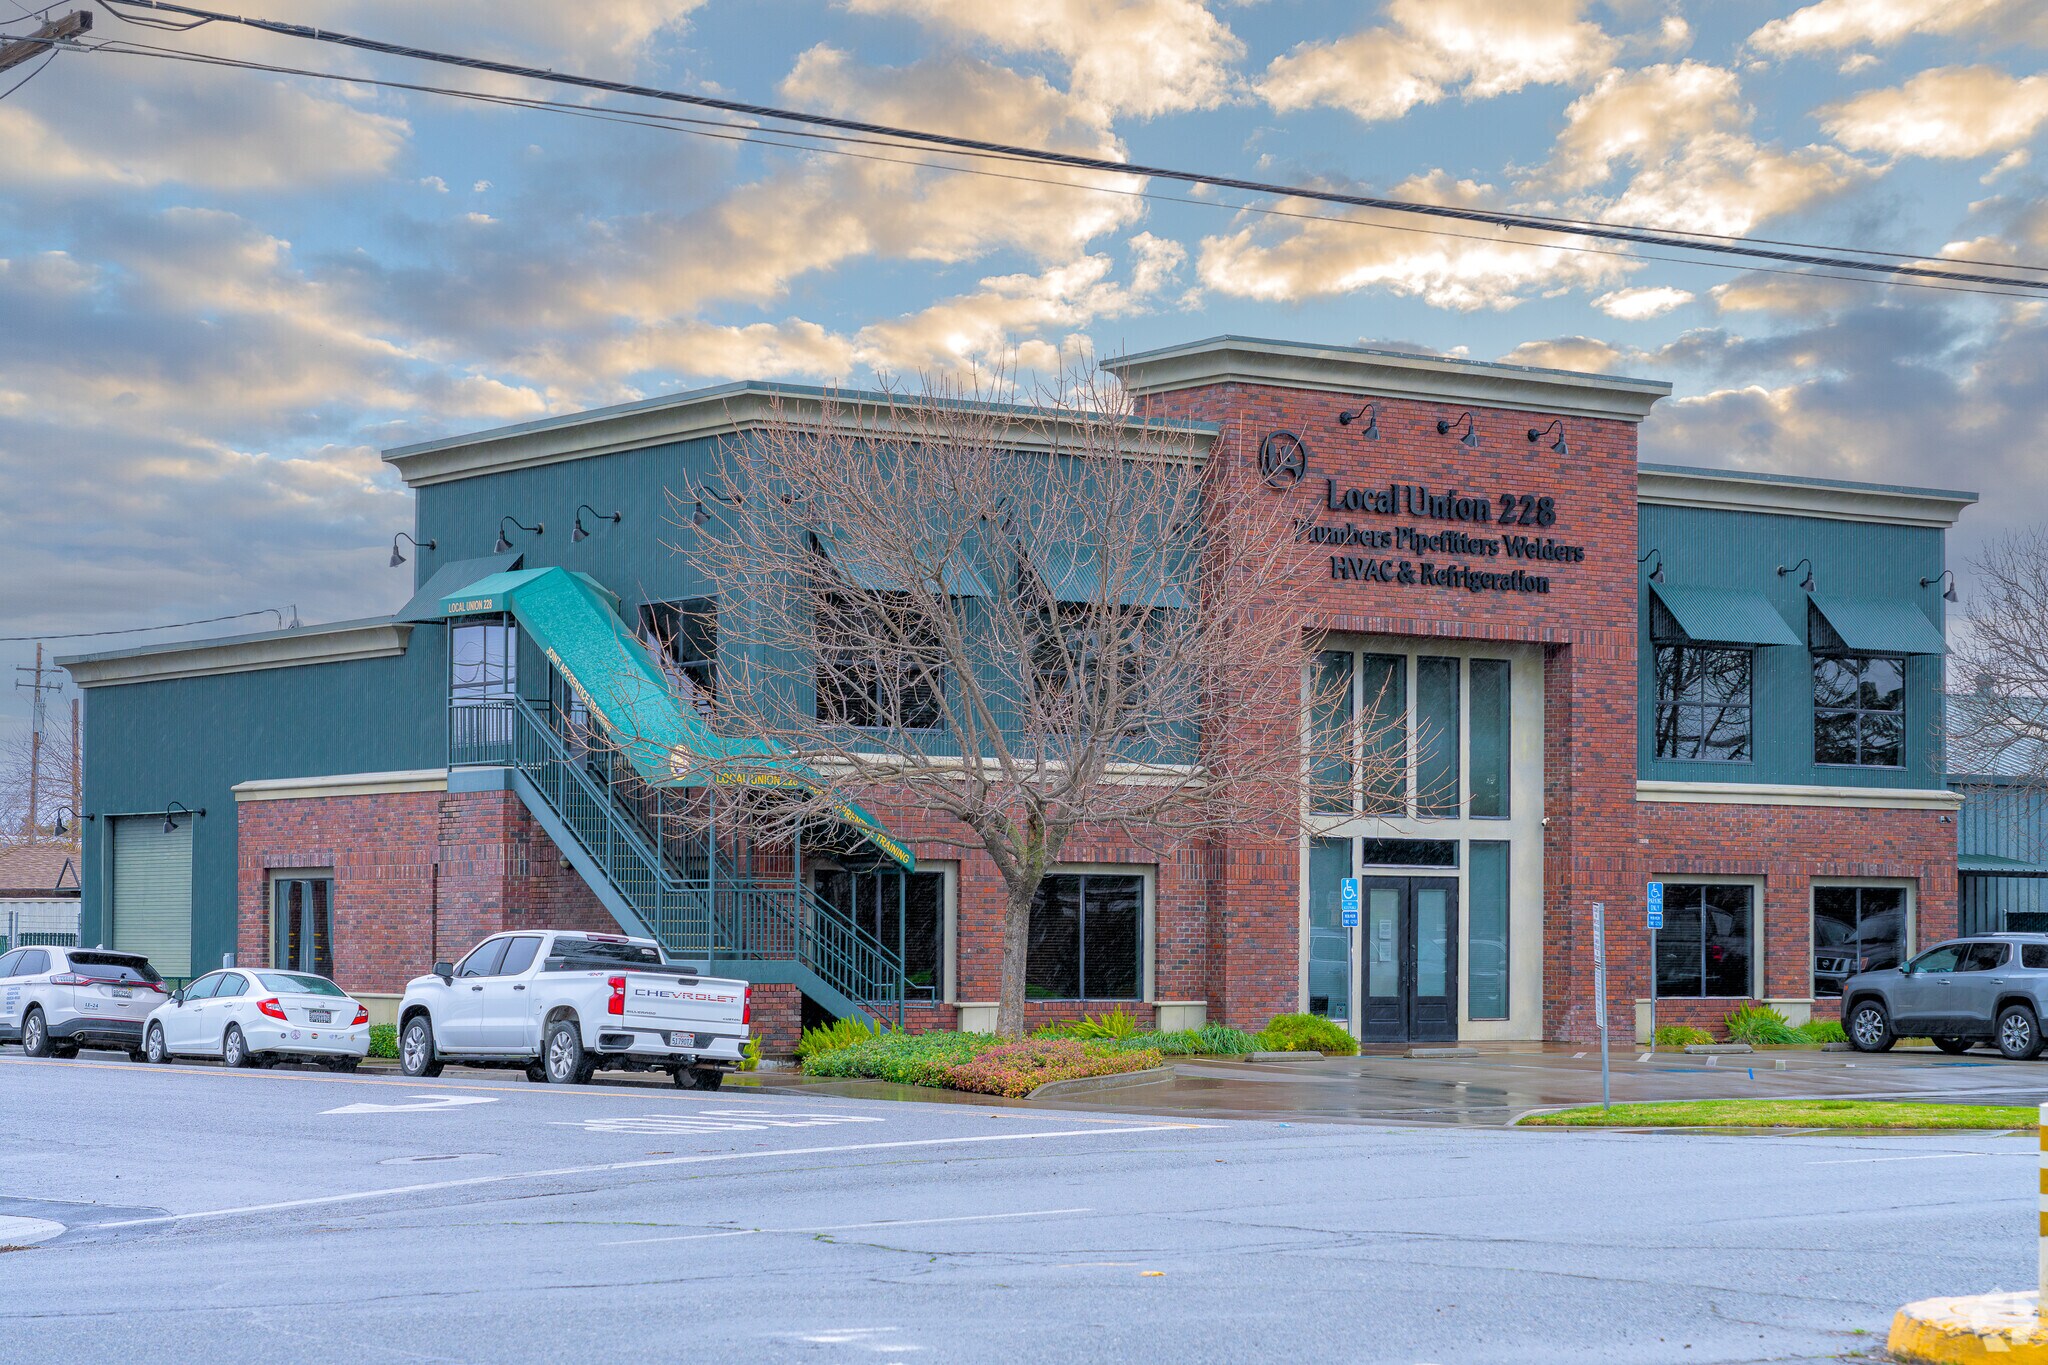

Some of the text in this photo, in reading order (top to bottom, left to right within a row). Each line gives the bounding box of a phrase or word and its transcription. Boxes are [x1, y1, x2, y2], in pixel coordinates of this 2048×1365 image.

[1326, 479, 1557, 528] Local Union 228
[1395, 526, 1500, 556] Pipefitters
[1502, 534, 1586, 562] Welders
[1330, 556, 1551, 593] HVAC & Refrigeration
[448, 599, 493, 613] LOCAL UNION 228
[546, 646, 562, 667] JOINT
[560, 663, 591, 705] APPRENTICE
[716, 772, 746, 785] LOCAL
[751, 773, 781, 786] UNION
[876, 833, 910, 864] TRAINING
[635, 988, 738, 1003] CHEVROLET
